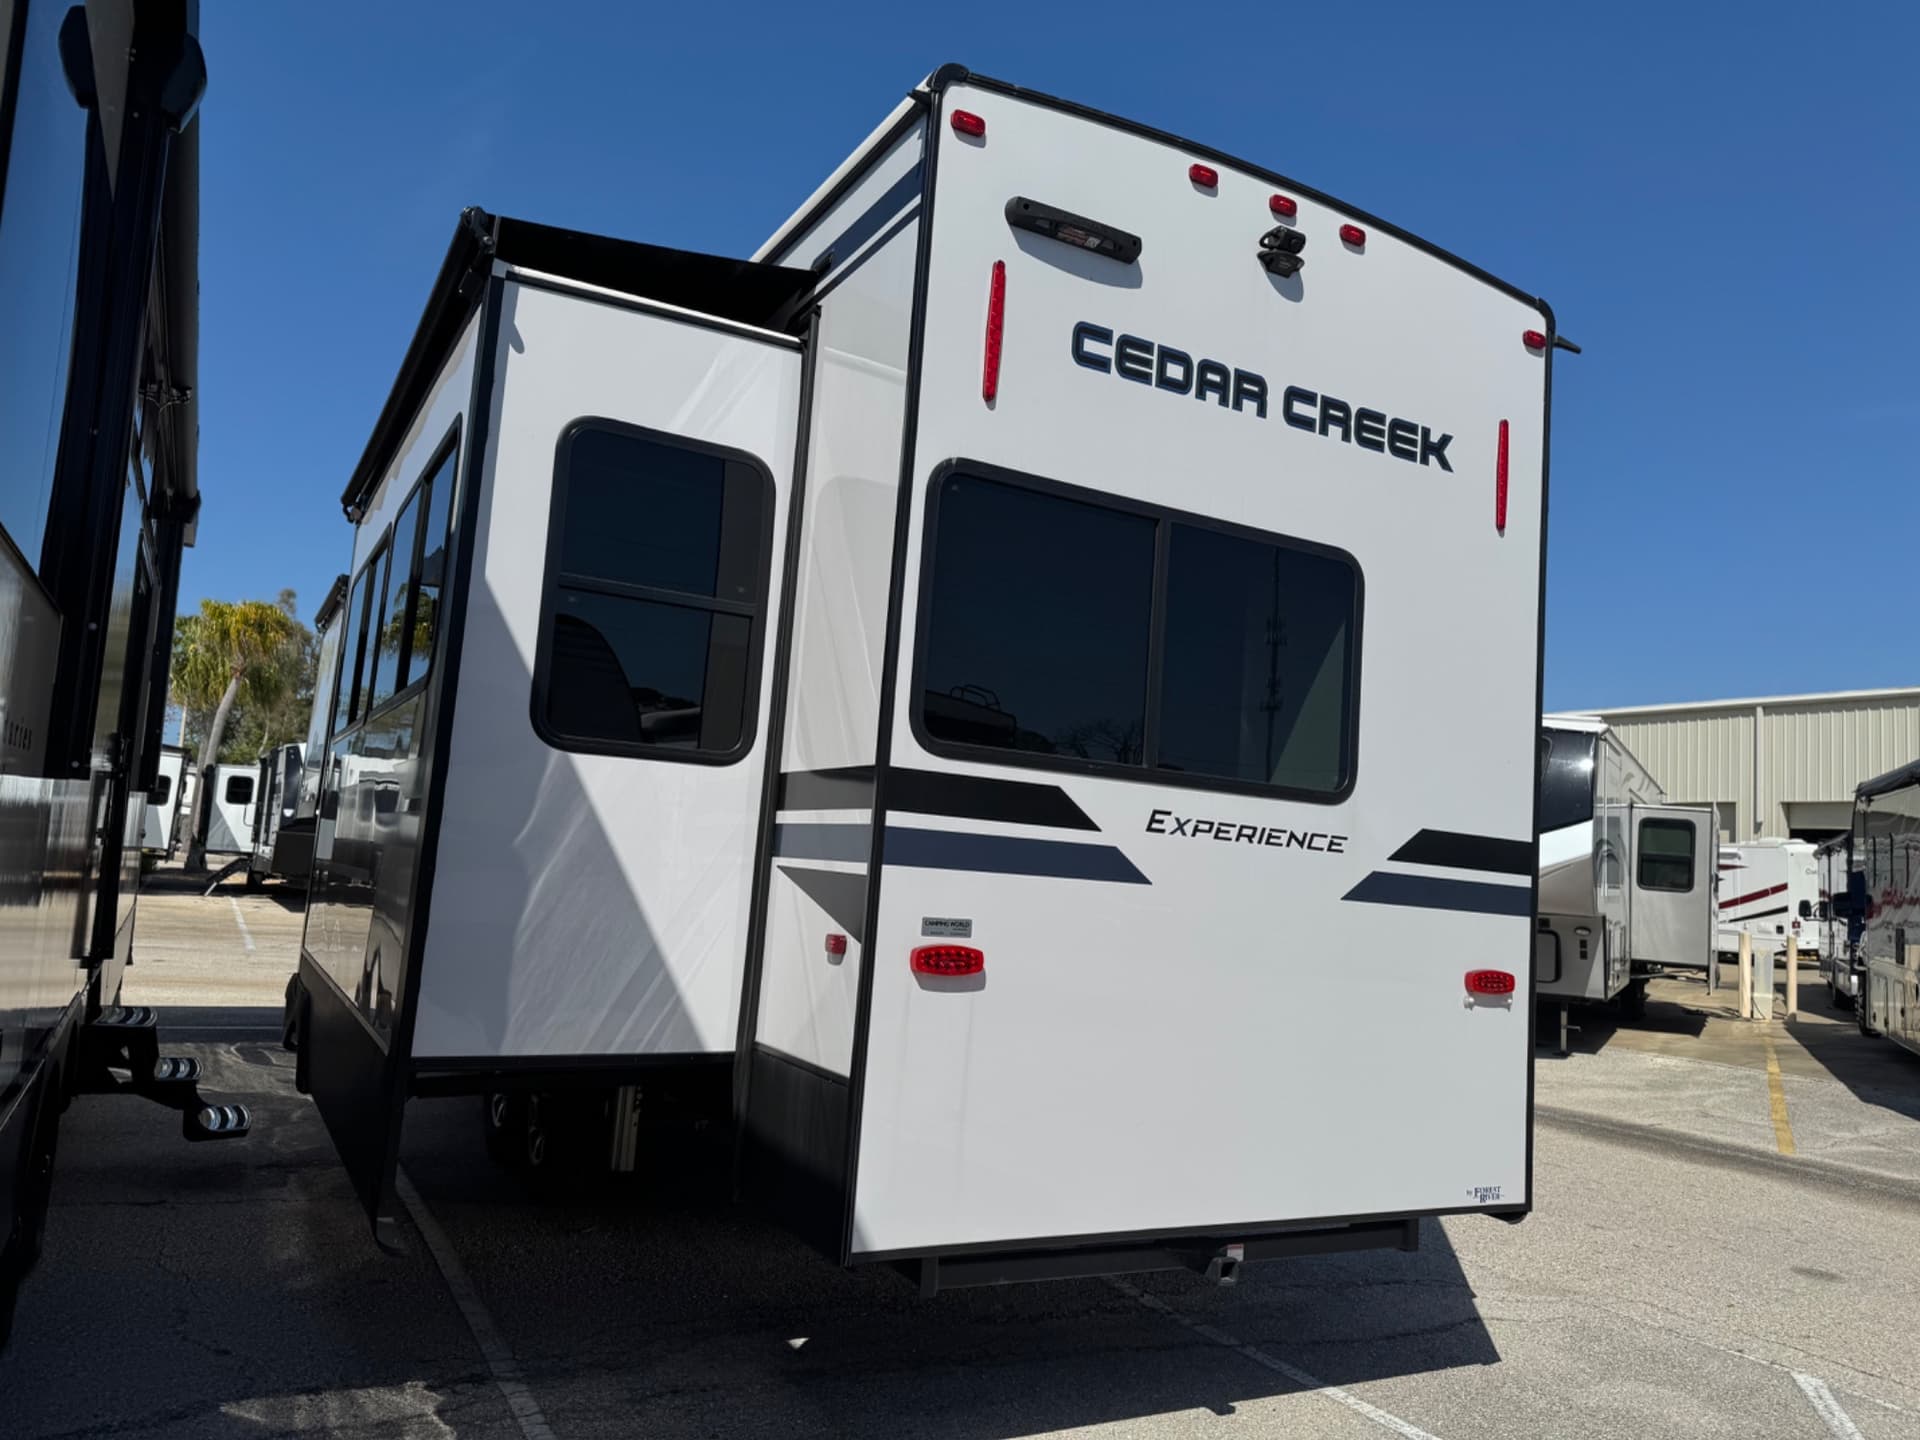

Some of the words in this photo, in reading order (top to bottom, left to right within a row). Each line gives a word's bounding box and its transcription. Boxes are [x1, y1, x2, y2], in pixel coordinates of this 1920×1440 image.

[1072, 321, 1269, 418] CEDAR
[1283, 386, 1454, 472] CREEK
[1145, 809, 1349, 853] EXPERIENCE
[950, 920, 970, 928] WORLD
